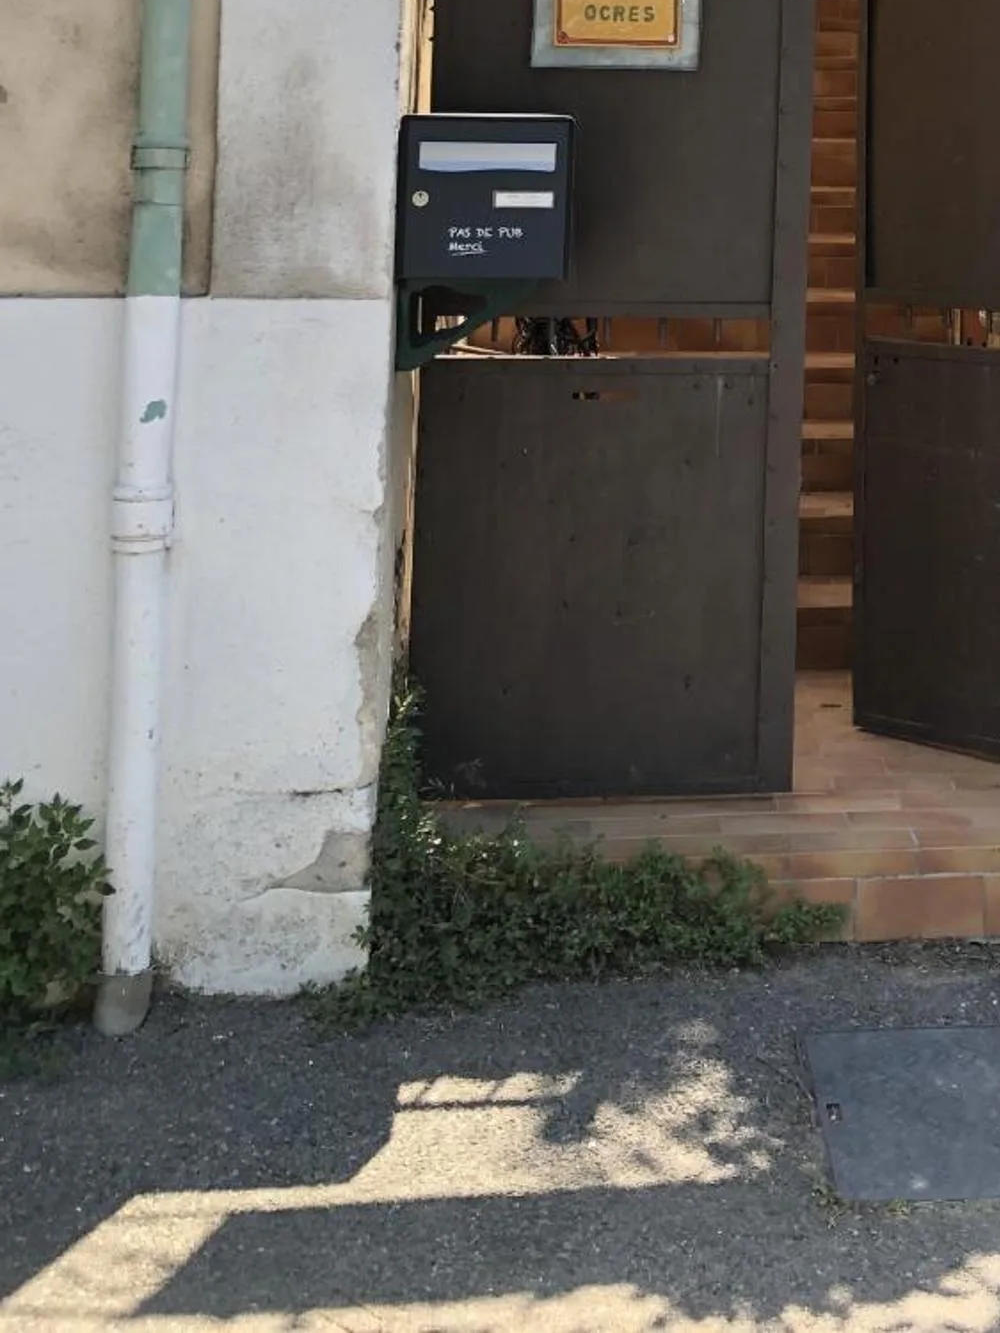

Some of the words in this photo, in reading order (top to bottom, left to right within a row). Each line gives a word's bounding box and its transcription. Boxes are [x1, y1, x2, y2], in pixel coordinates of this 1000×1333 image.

[584, 4, 656, 23] OCRES
[448, 226, 472, 239] PAS
[476, 227, 494, 238] DE
[498, 226, 524, 239] PUB
[448, 241, 485, 252] Merci
